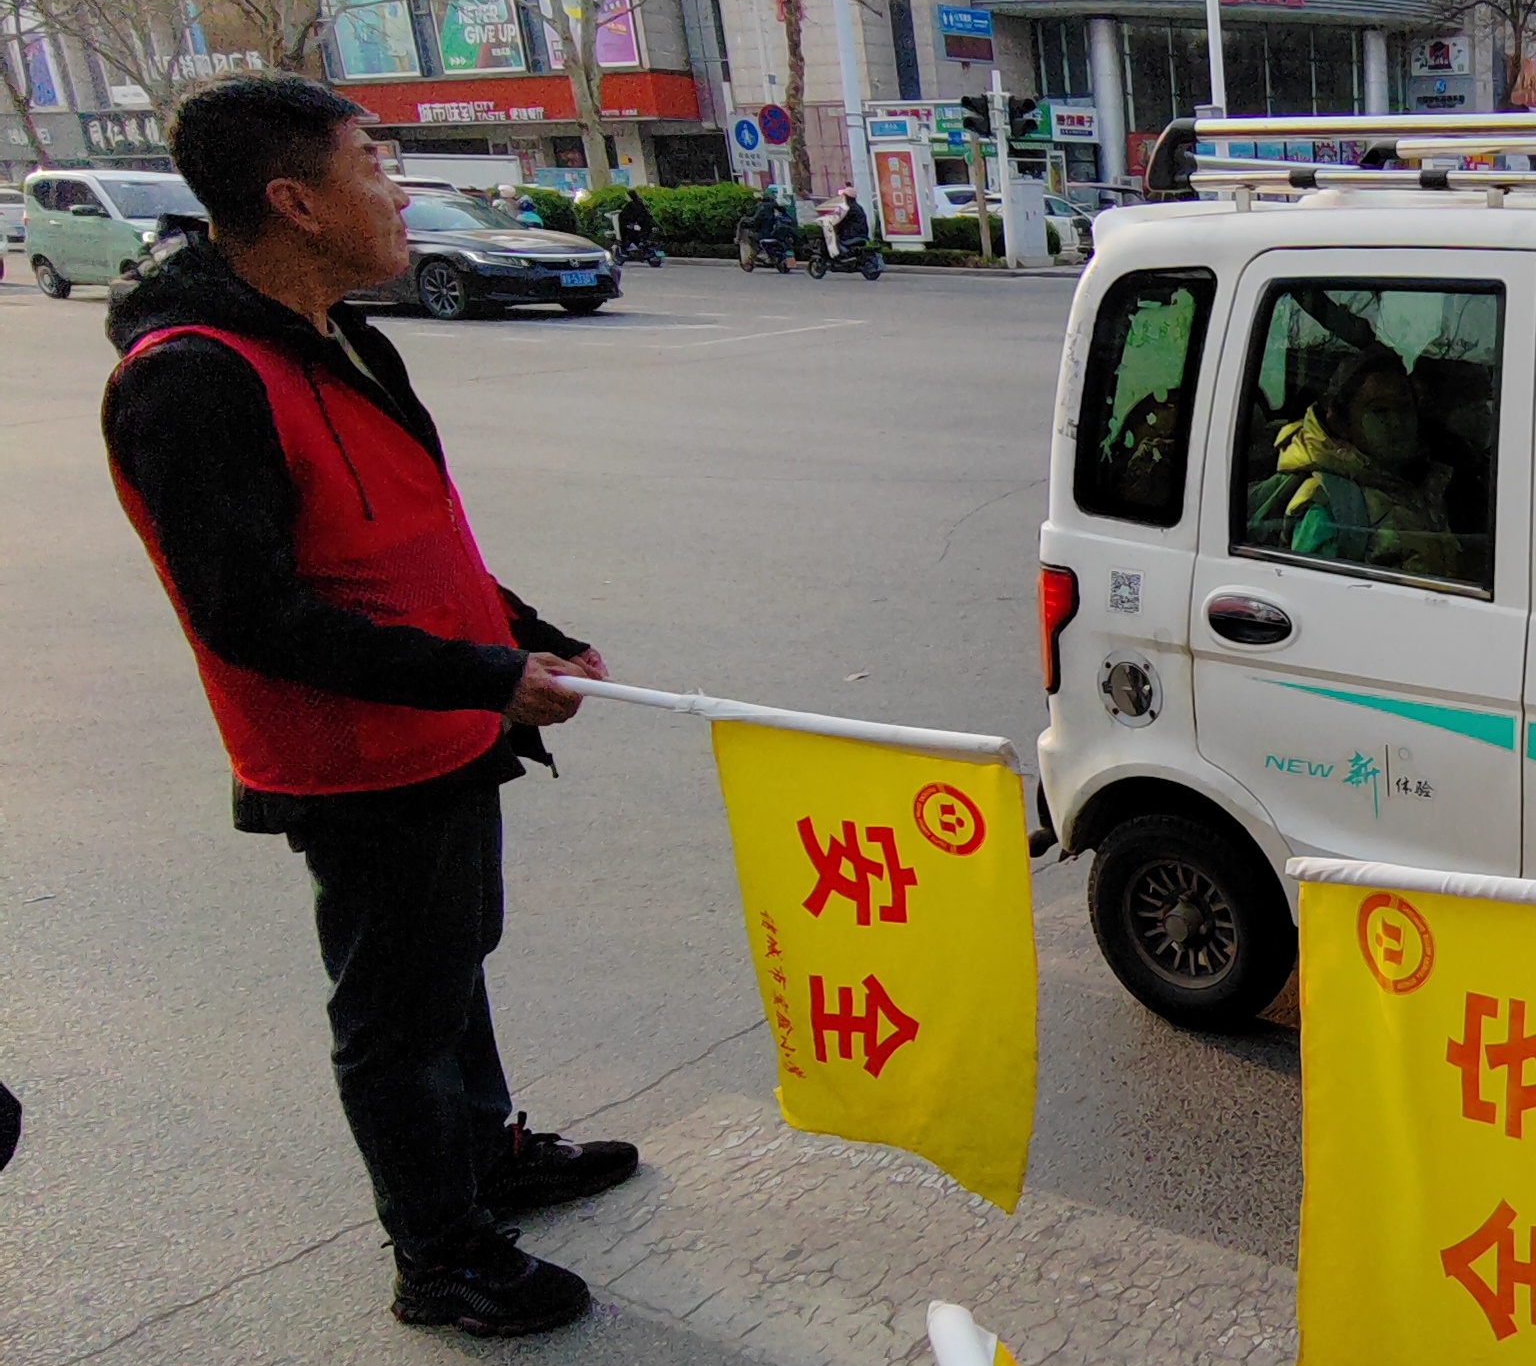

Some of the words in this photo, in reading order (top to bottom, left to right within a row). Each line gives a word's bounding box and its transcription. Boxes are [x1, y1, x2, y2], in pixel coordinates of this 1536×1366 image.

[465, 25, 496, 44] GIVE
[497, 23, 516, 43] UP
[474, 101, 494, 111] CITY
[476, 111, 506, 121] TASTE
[1265, 754, 1335, 778] NEW
[1341, 750, 1380, 819] 新
[1395, 776, 1434, 799] 体验
[797, 815, 920, 1079] 安全
